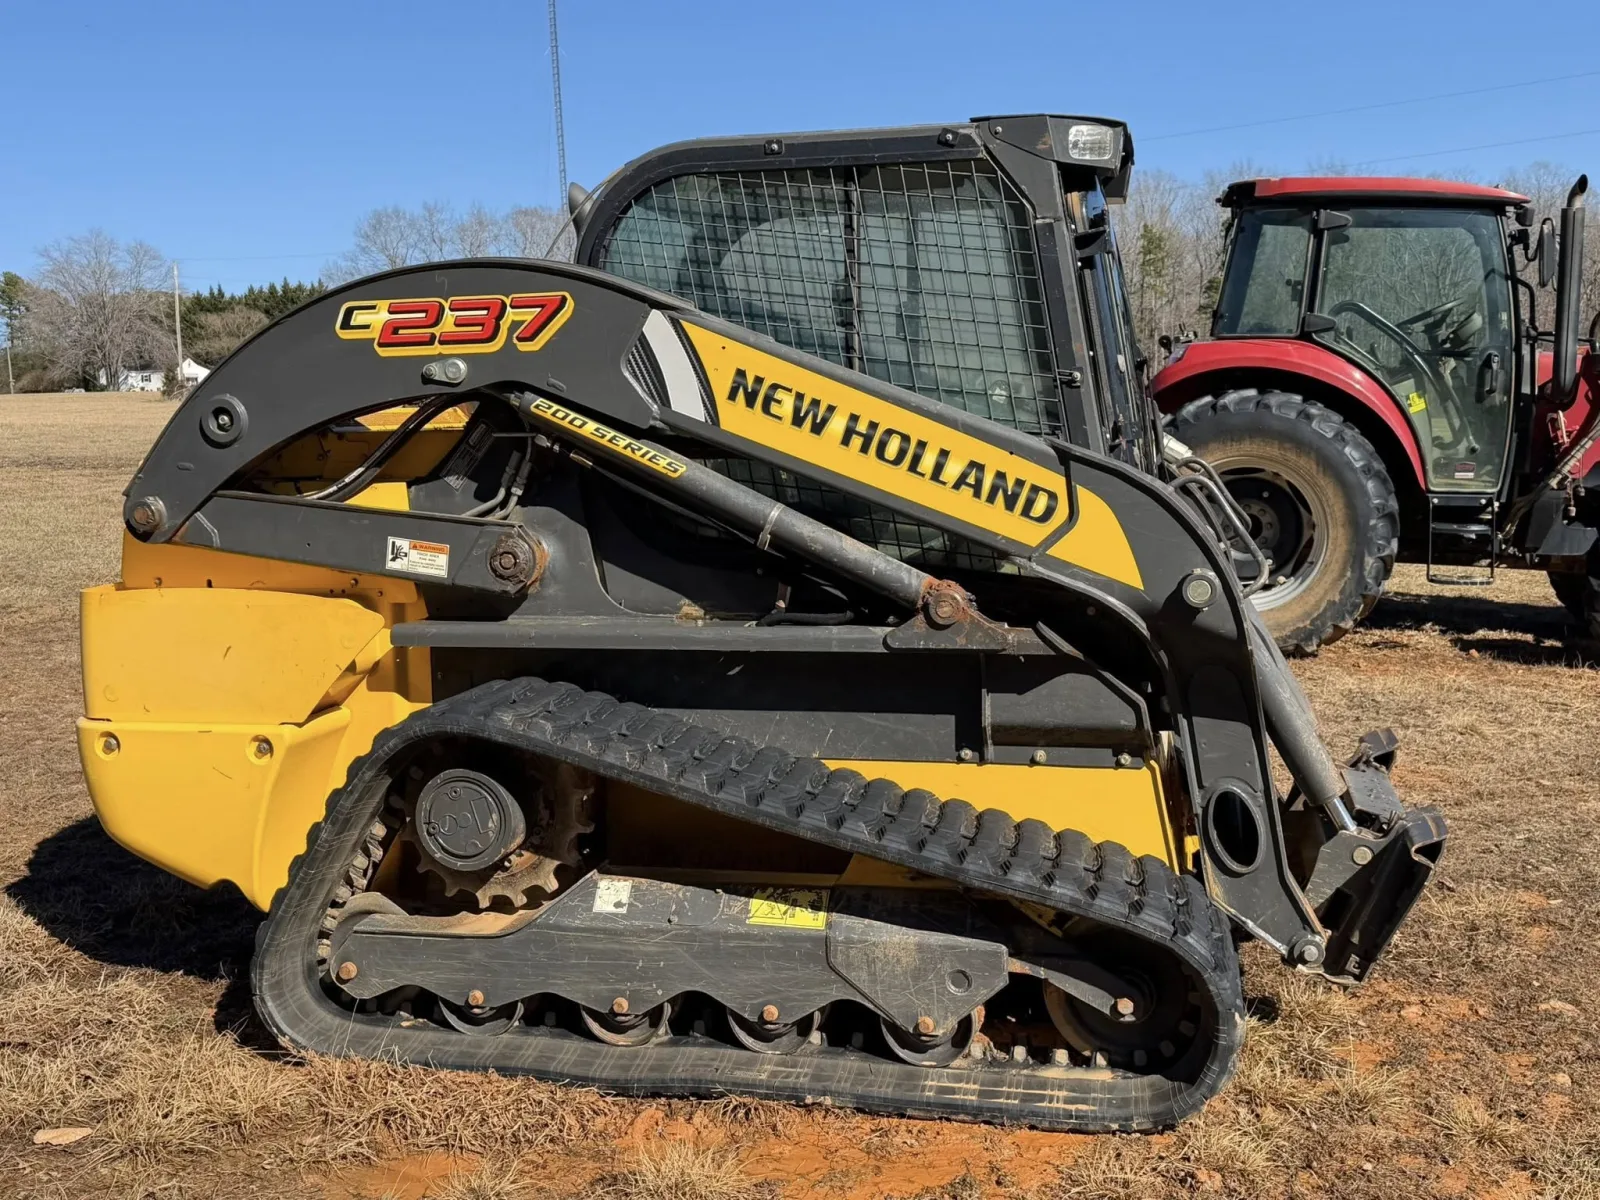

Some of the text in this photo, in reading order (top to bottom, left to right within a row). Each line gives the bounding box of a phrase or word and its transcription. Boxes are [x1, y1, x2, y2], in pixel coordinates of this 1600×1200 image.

[338, 293, 571, 349] C237
[533, 400, 684, 474] 200 SERIES
[725, 366, 1060, 525] NEW HOLLAND
[419, 543, 445, 553] WARNING
